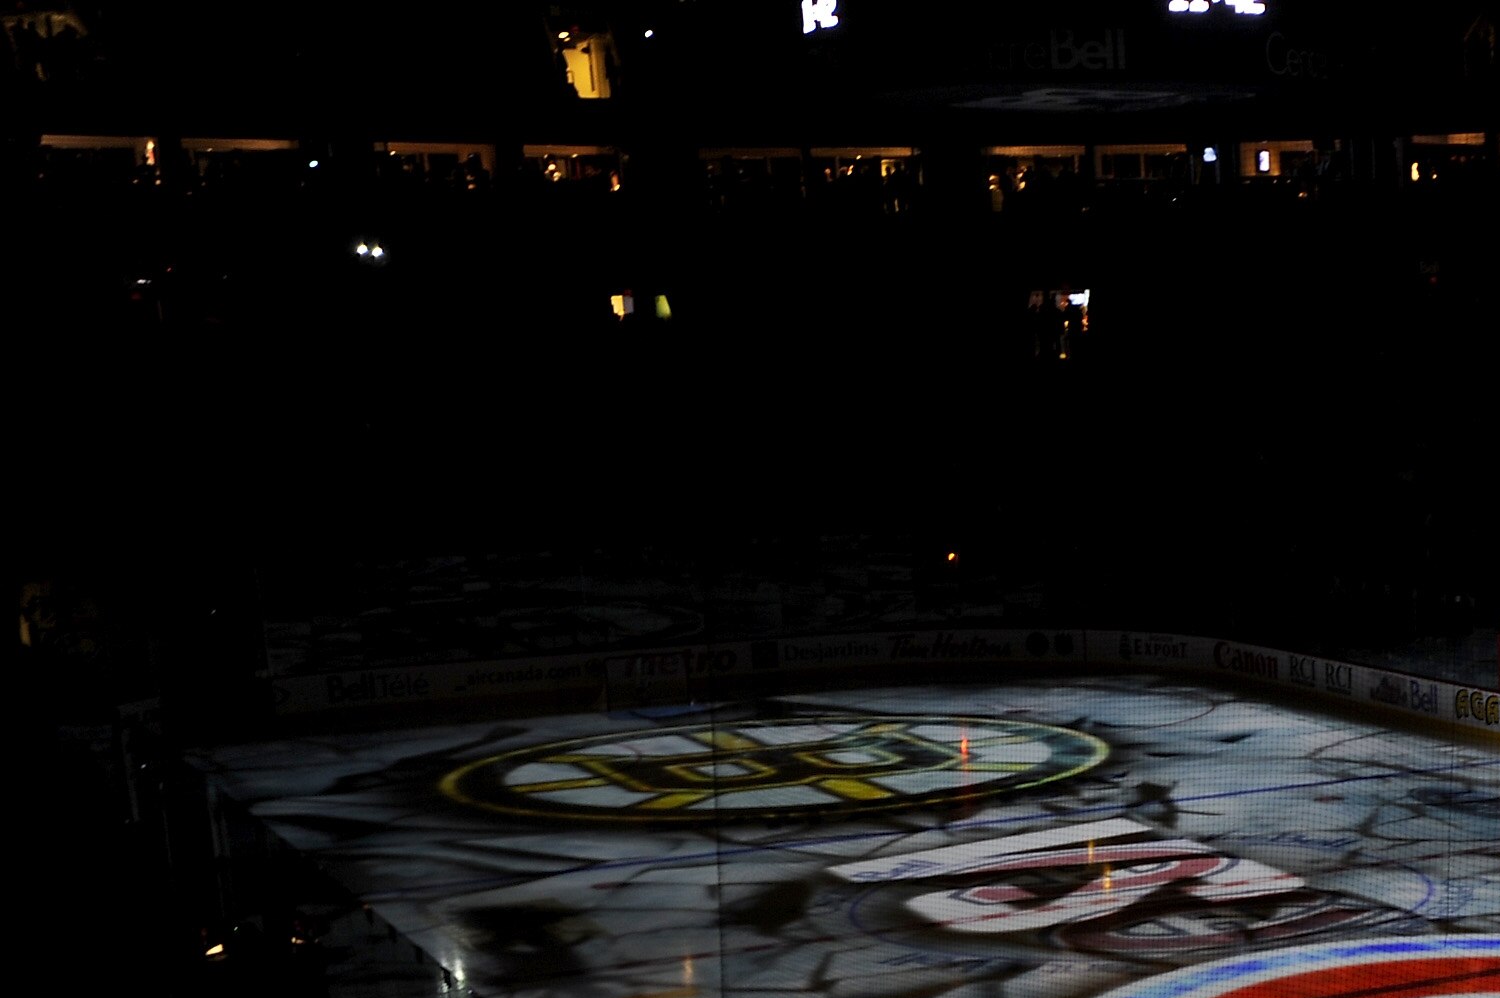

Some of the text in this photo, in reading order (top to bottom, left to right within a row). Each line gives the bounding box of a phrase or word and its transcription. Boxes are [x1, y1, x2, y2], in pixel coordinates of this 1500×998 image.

[1050, 26, 1127, 72] Bell
[784, 641, 879, 662] Desjardins
[889, 632, 1012, 659] Tim Hortons
[1214, 641, 1280, 680] Canon
[466, 664, 581, 688] aircanada.com
[1409, 680, 1438, 714] Bell
